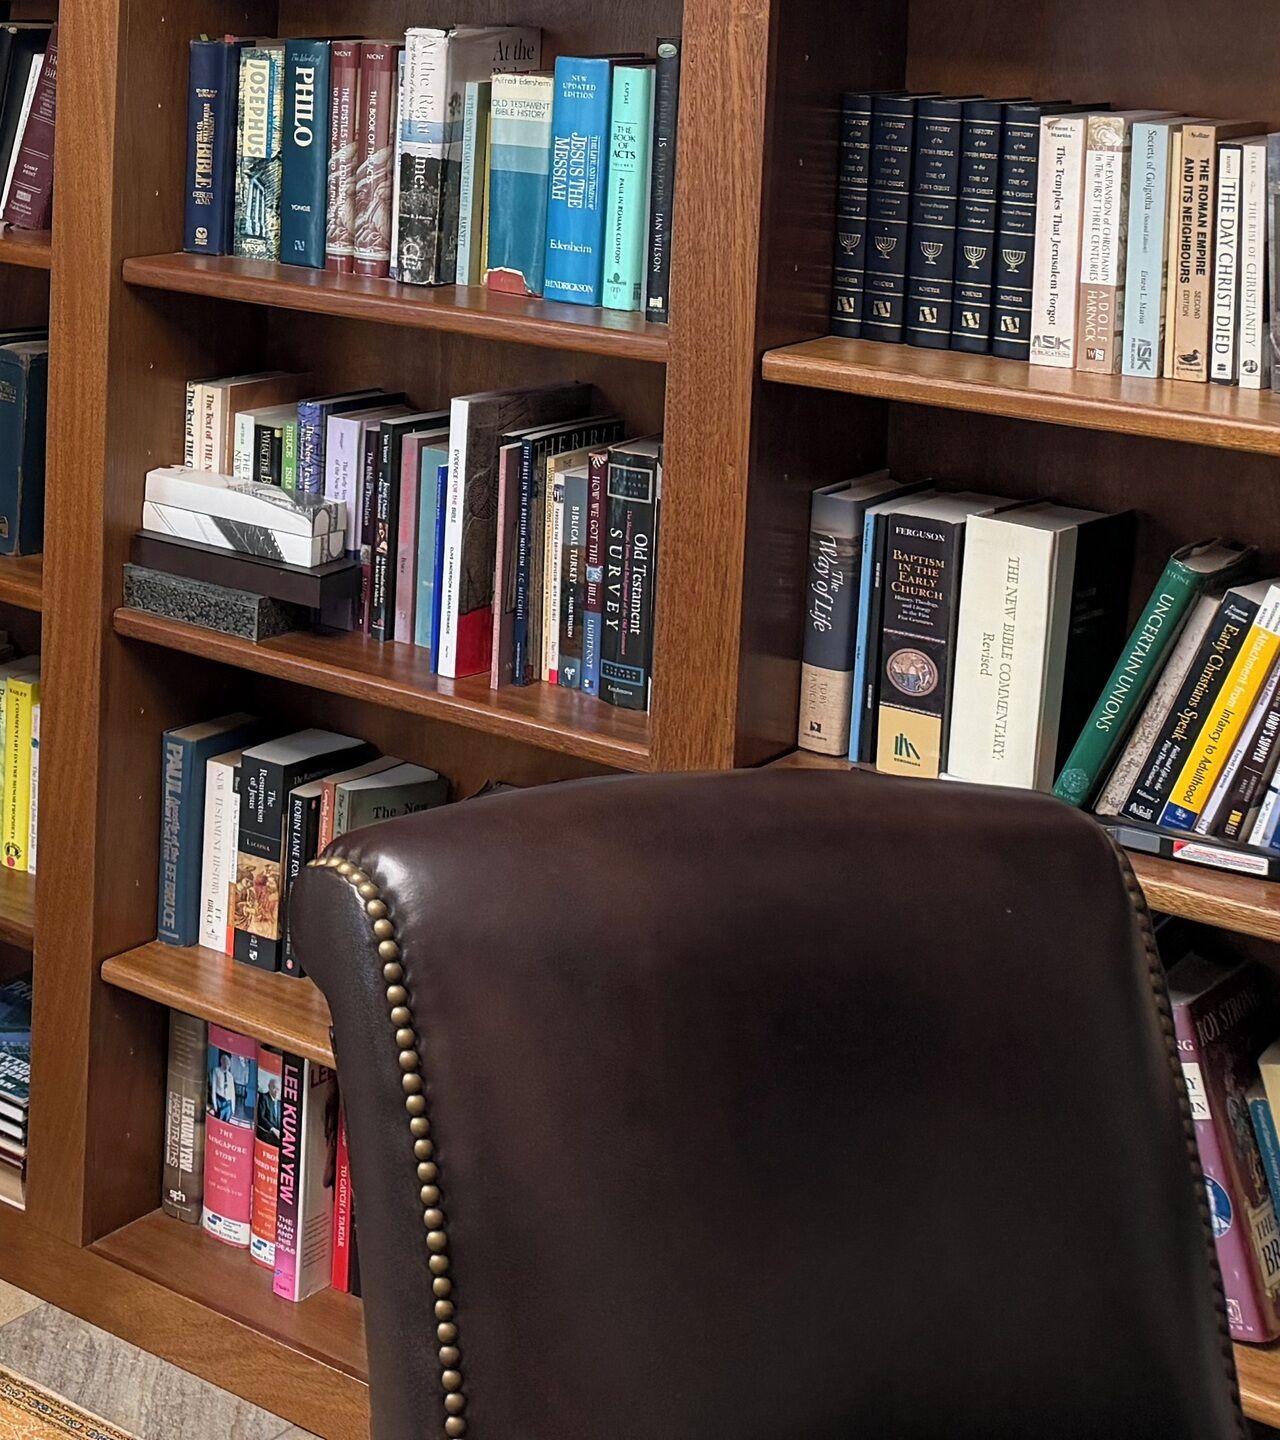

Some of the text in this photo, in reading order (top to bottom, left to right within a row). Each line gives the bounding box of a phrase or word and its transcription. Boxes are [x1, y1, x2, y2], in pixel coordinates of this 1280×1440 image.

[563, 82, 596, 91] UPDATED
[563, 91, 594, 100] EDITION
[571, 74, 587, 82] NEW
[247, 63, 266, 154] JOSEPHUS
[294, 66, 314, 147] PHILO
[495, 108, 545, 119] BIBLE HISTORY
[511, 100, 550, 110] TESTAMENT
[552, 136, 570, 200] MESSIAH
[568, 132, 587, 209] JESUS THE
[1180, 157, 1195, 284] AND ITS NEIGHBOURS
[1196, 158, 1210, 276] THE ROMAN EMPIRE
[550, 239, 592, 254] Edersheim
[545, 279, 593, 294] HENDRICKSON
[1214, 182, 1236, 354] THE DAY CHRIST DIED
[895, 526, 946, 542] FERGUSON
[606, 528, 623, 631] SURVEY
[892, 549, 945, 569] BAPTISM
[898, 562, 940, 578] IN THE
[898, 571, 938, 588] EARLY
[1005, 556, 1020, 585] THE
[630, 533, 648, 635] Old Testament
[809, 535, 839, 633] Way of Life
[830, 570, 844, 593] The
[891, 581, 943, 601] CHURCH
[1004, 586, 1018, 620] NEW
[980, 631, 995, 678] Revised
[1000, 622, 1015, 660] BIBLE
[1096, 593, 1175, 732] UNCERTAIN UNIONS
[1171, 623, 1240, 742] Early Christians Speak
[1183, 633, 1269, 805] Attachment from Infancy to Adulthood
[291, 800, 302, 877] ROBIN LANE FOX
[279, 1064, 298, 1205] LEE KUAN YEW
